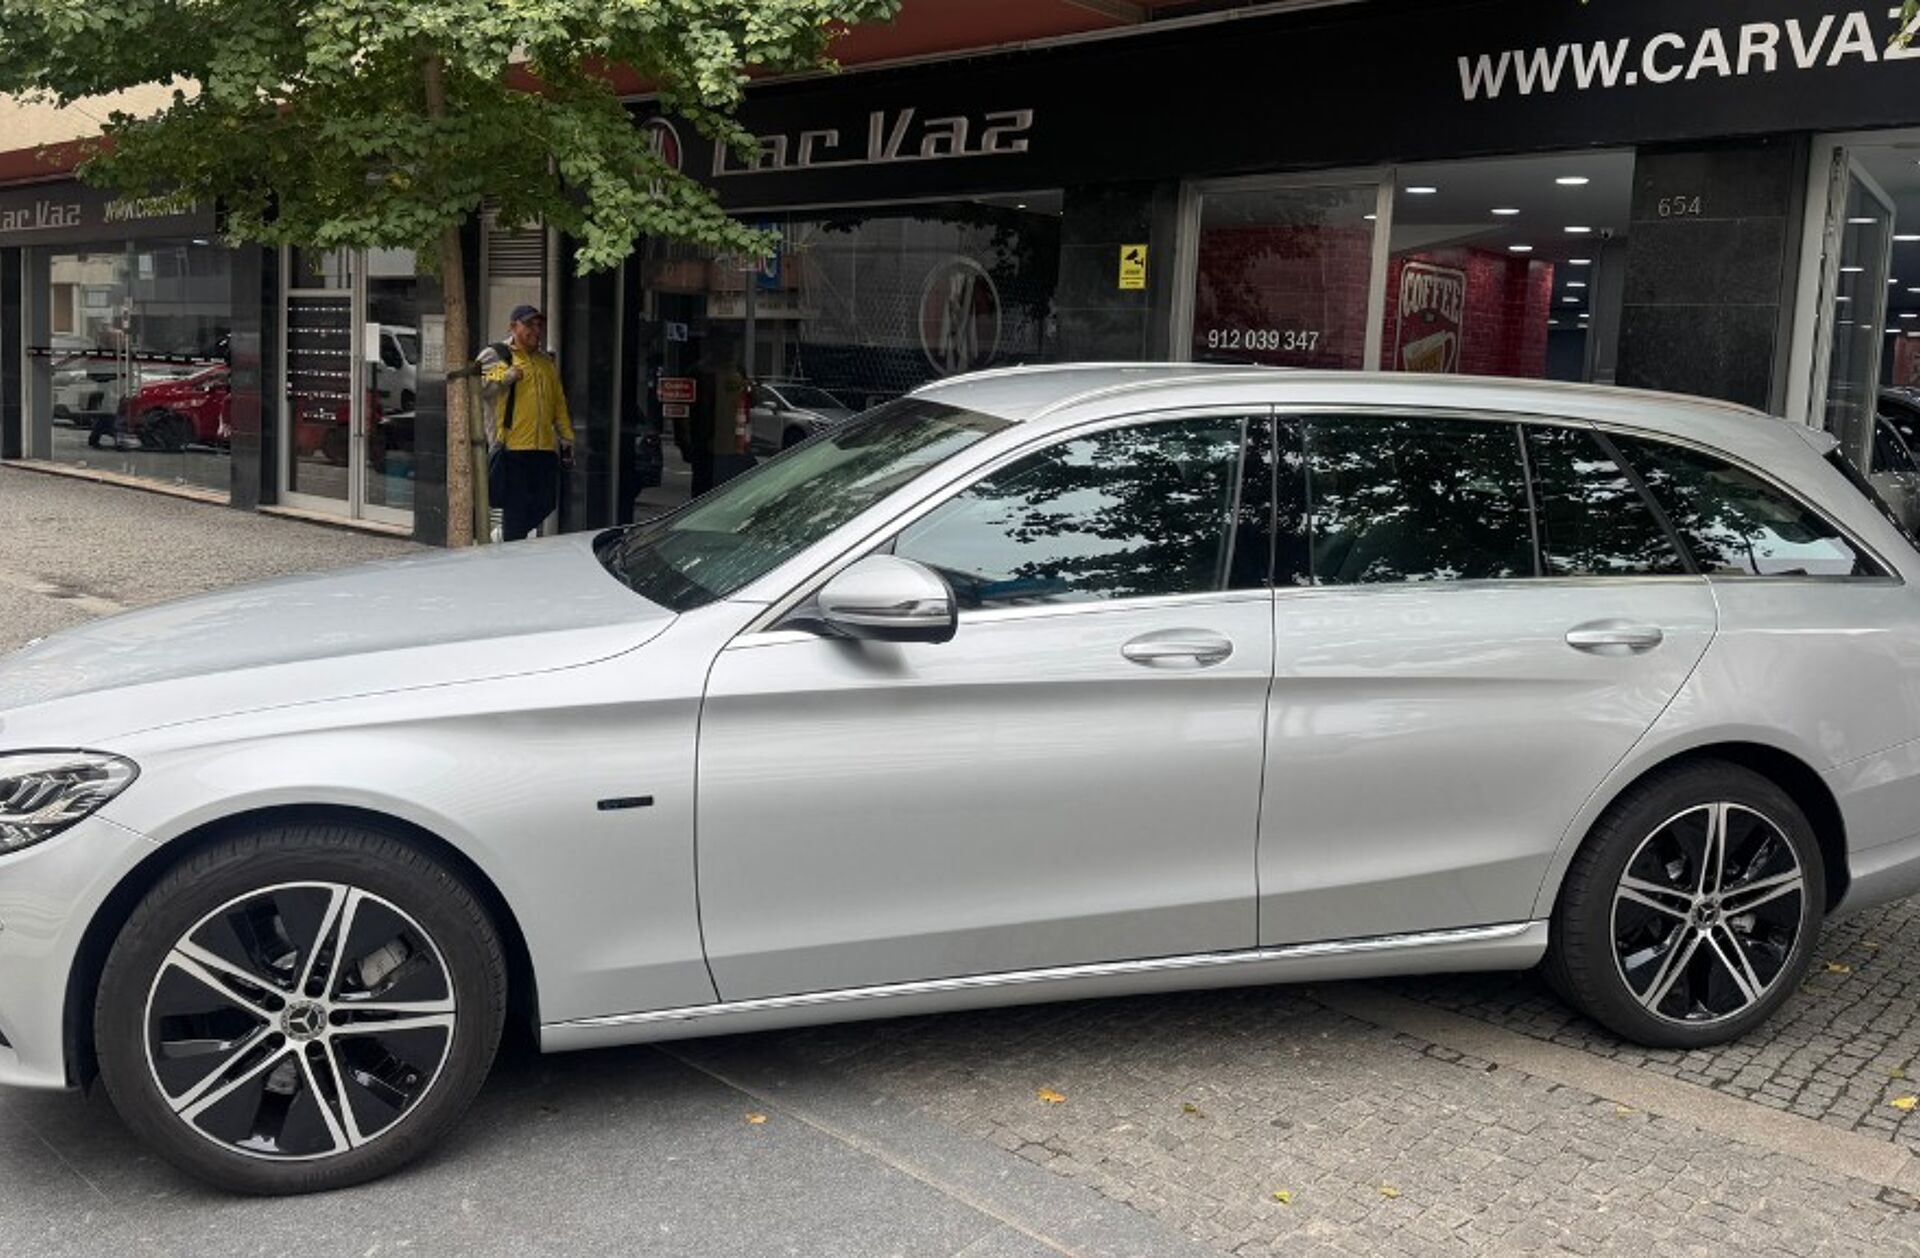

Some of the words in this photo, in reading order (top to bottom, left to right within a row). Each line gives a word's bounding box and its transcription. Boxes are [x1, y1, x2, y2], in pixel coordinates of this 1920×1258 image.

[1457, 8, 1920, 101] WWW.CARVAZ
[867, 107, 1034, 162] Vaz
[0, 208, 29, 232] ar
[1658, 195, 1700, 217] 654
[1403, 271, 1462, 324] COFFEE
[1208, 329, 1240, 349] 912
[1245, 329, 1279, 350] 039
[1284, 330, 1319, 351] 347
